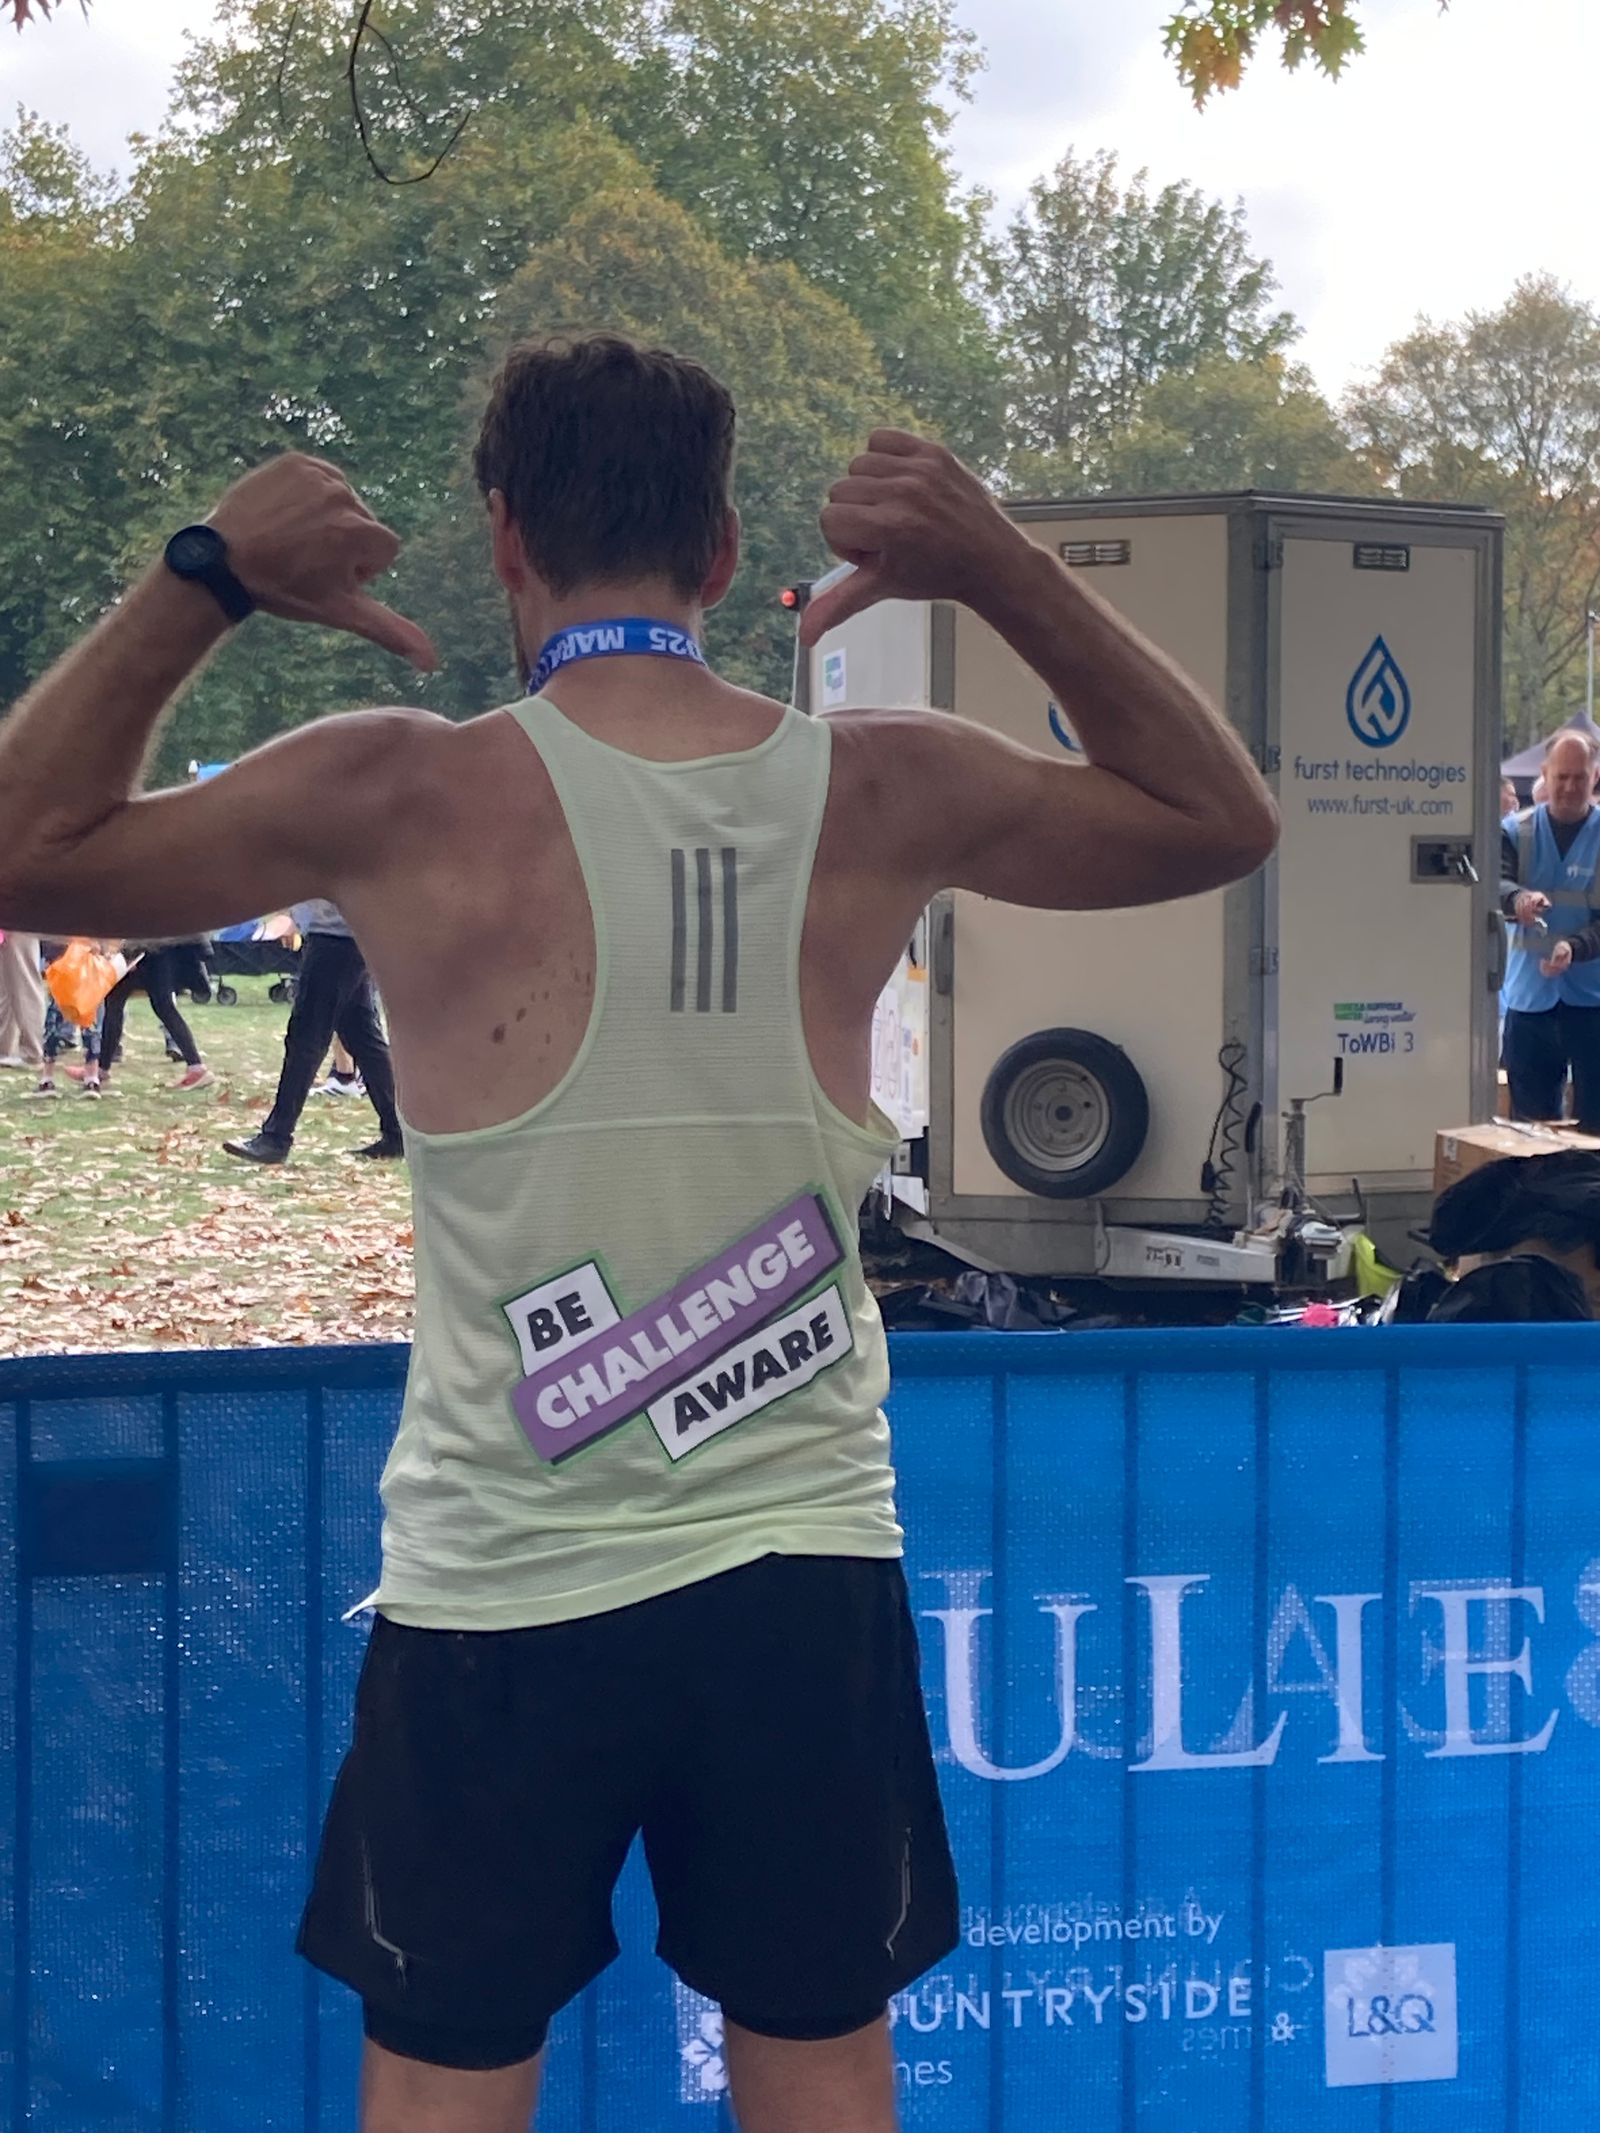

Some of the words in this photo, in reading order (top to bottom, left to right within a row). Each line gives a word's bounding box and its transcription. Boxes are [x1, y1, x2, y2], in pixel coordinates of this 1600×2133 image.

[1294, 756, 1339, 780] furst
[1346, 758, 1466, 789] technologies
[1307, 795, 1453, 816] www.furst-uk.com
[1403, 1032, 1414, 1053] 3
[526, 1290, 595, 1352] BE
[536, 1219, 816, 1430] CHALLENGE
[672, 1310, 834, 1436] AWARE
[920, 1573, 1600, 1781] ULIE
[967, 1911, 1177, 1951] development
[1187, 1904, 1225, 1945] by
[888, 1976, 1252, 2033] UNTRYSIDE
[1271, 2012, 1295, 2042] &
[1348, 1994, 1436, 2038] L&Q
